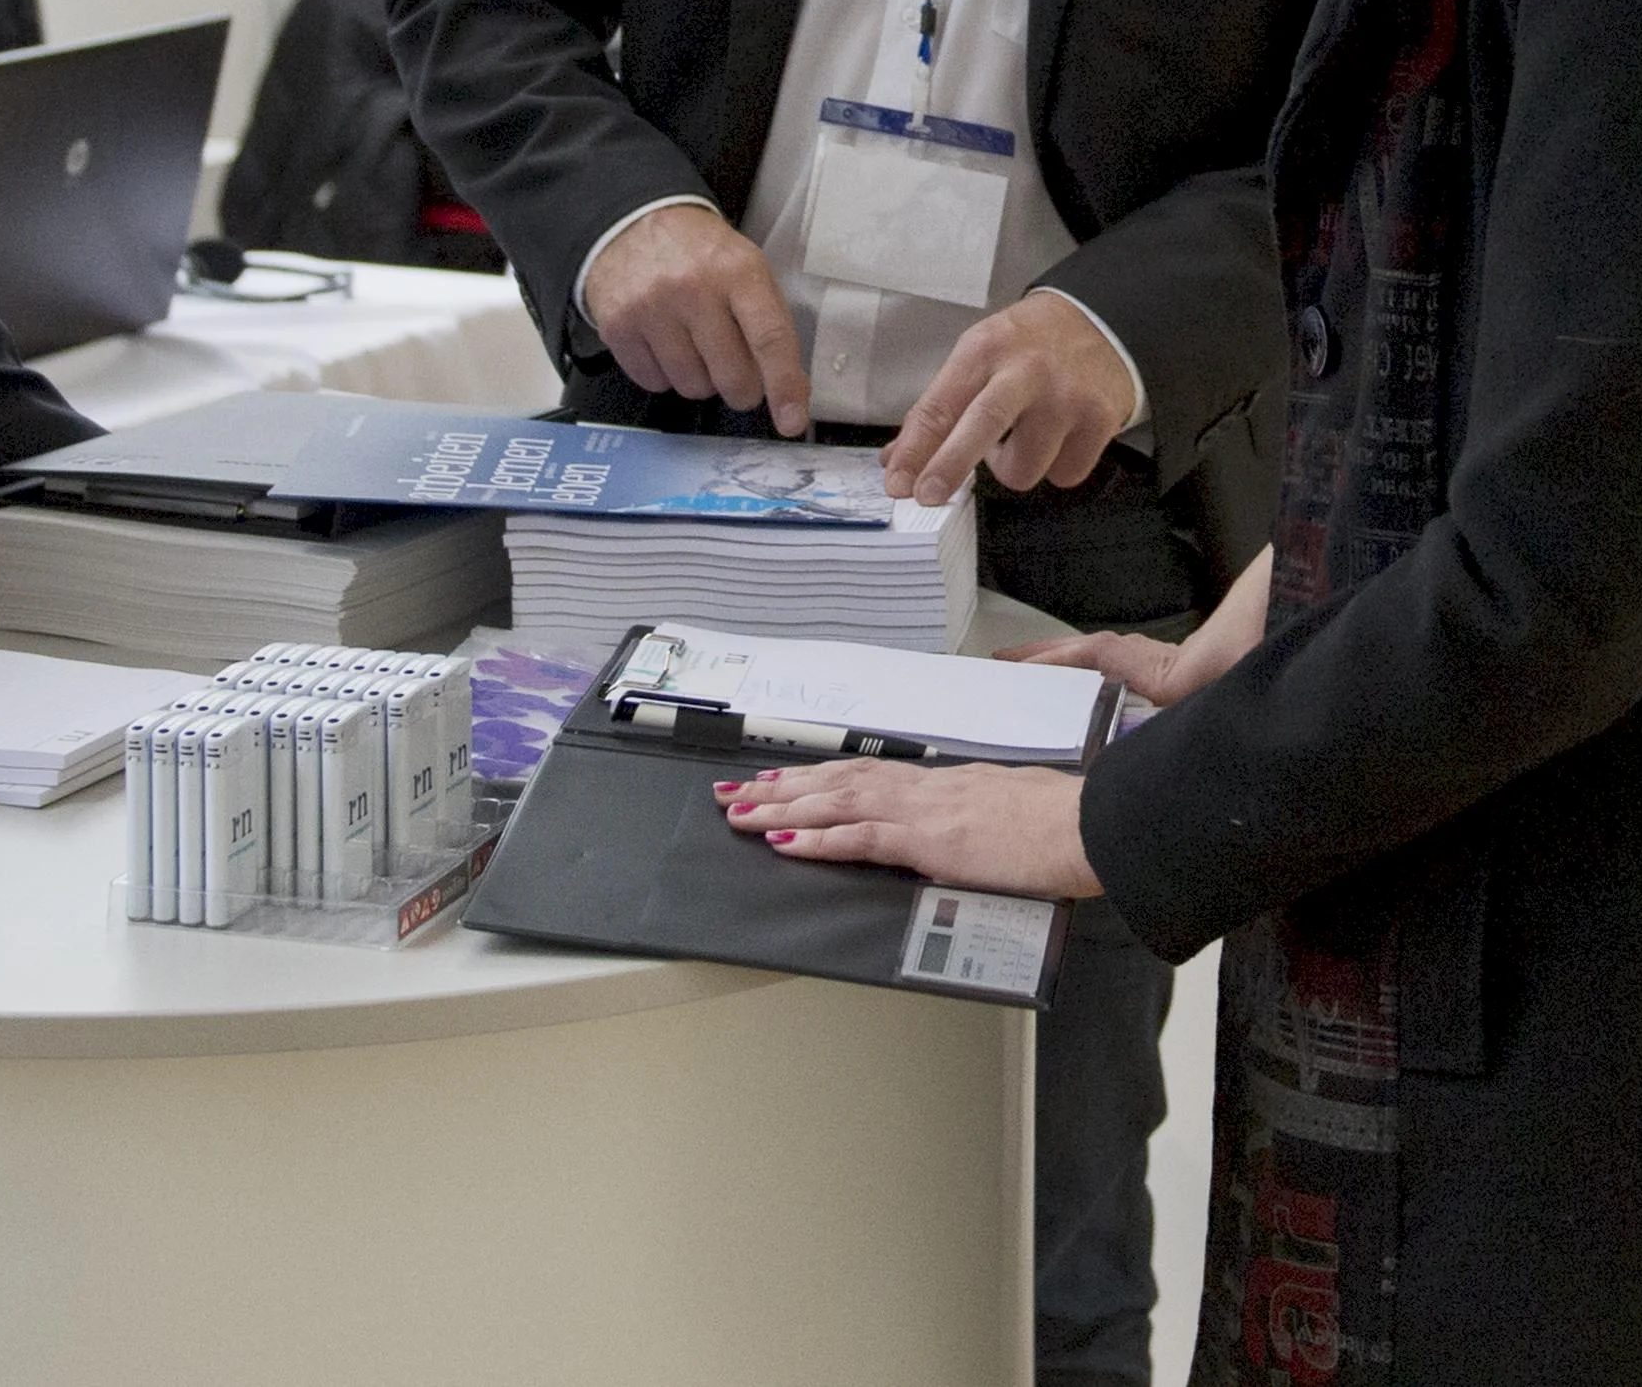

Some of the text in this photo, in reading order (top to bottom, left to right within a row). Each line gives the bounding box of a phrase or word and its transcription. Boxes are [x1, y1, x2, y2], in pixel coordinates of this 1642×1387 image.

[397, 431, 489, 502] arbeiten
[466, 437, 555, 493] lernen
[528, 463, 612, 507] leben
[413, 766, 433, 800] rn
[231, 808, 253, 844] rn
[348, 791, 368, 827] rn
